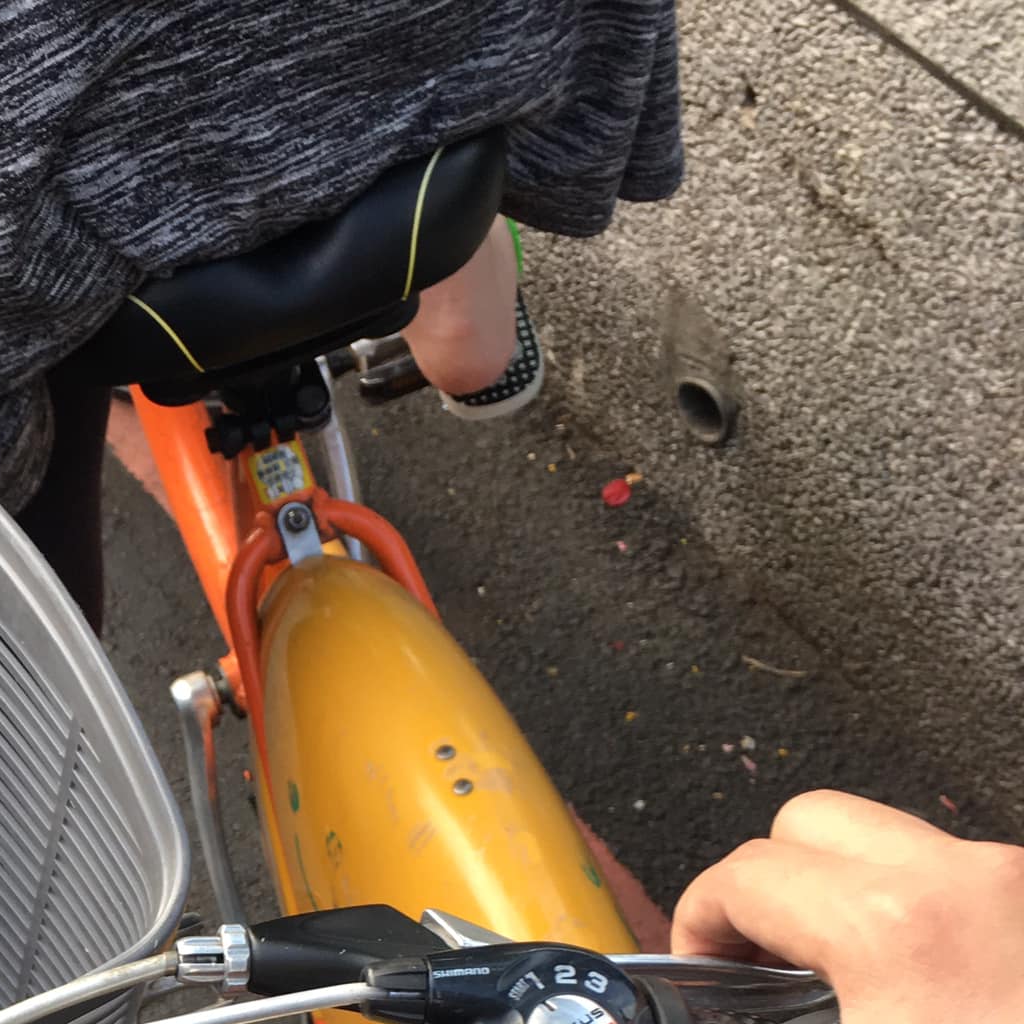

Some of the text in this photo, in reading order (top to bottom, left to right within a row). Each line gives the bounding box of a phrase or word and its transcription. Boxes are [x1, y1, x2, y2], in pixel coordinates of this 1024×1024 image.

[432, 966, 490, 980] SHIMANO
[527, 964, 609, 994] 1 2 3
